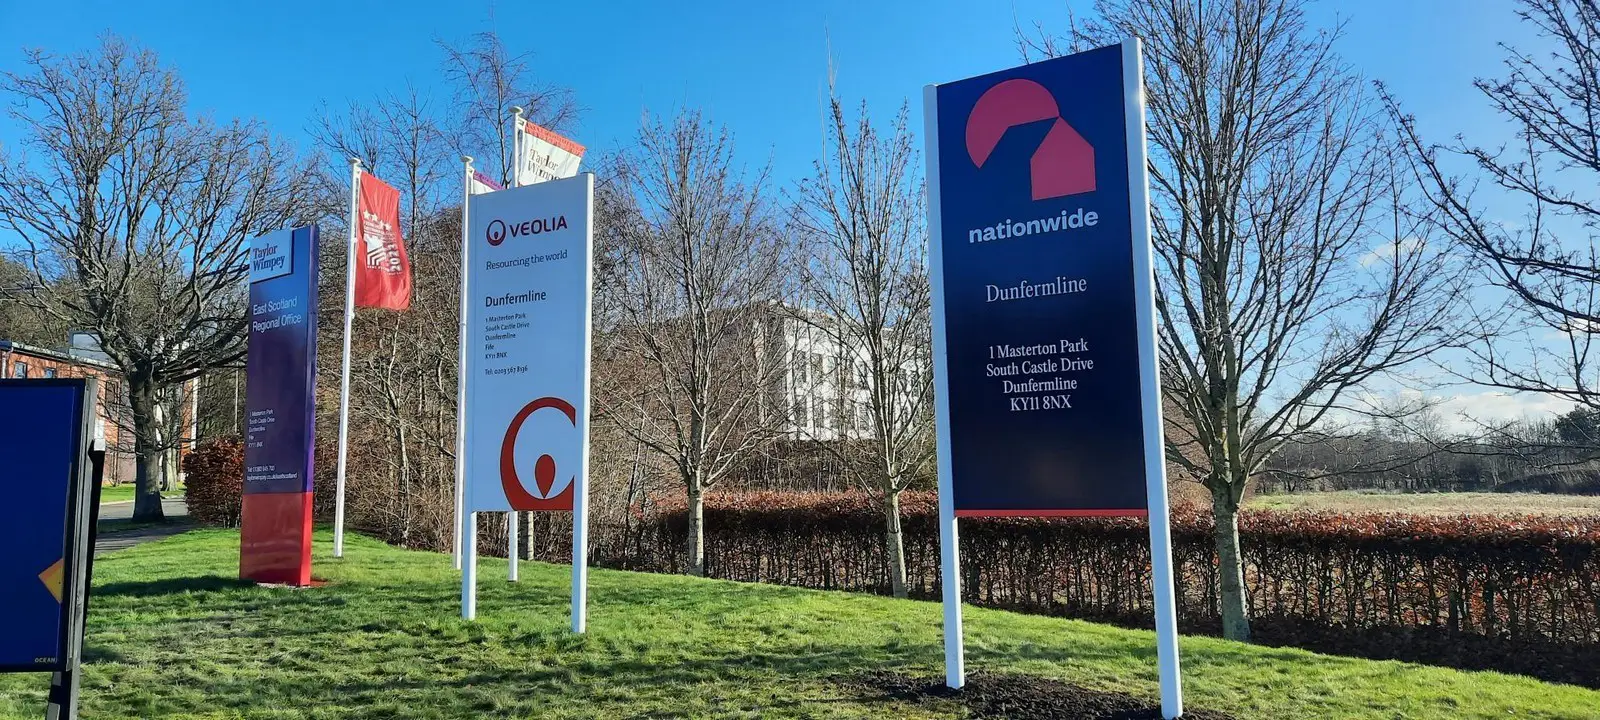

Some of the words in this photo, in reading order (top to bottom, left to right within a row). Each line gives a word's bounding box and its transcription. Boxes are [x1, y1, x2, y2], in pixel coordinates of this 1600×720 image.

[529, 148, 559, 171] Taylor
[509, 215, 568, 238] VEOLIA
[969, 208, 1099, 243] nationwide
[253, 243, 278, 261] Taylor
[486, 257, 530, 271] Resourcing
[531, 254, 544, 264] the
[545, 249, 568, 262] world
[253, 255, 285, 271] Wimpey
[485, 290, 546, 307] Dunfermline
[985, 277, 1087, 303] Dunfermline
[253, 304, 267, 316] East
[268, 296, 297, 313] Scotland
[252, 317, 280, 333] Regional
[281, 314, 302, 327] Office
[485, 333, 516, 341] Dunfermline
[989, 346, 994, 359] 1
[997, 340, 1057, 359] Masterton
[1060, 338, 1089, 353] Park
[986, 363, 1019, 377] South
[1022, 359, 1058, 375] Castle
[1060, 357, 1094, 372] Drive
[1003, 378, 1078, 393] Dunfermline
[1010, 397, 1040, 411] KY11
[1042, 395, 1072, 409] 8NX
